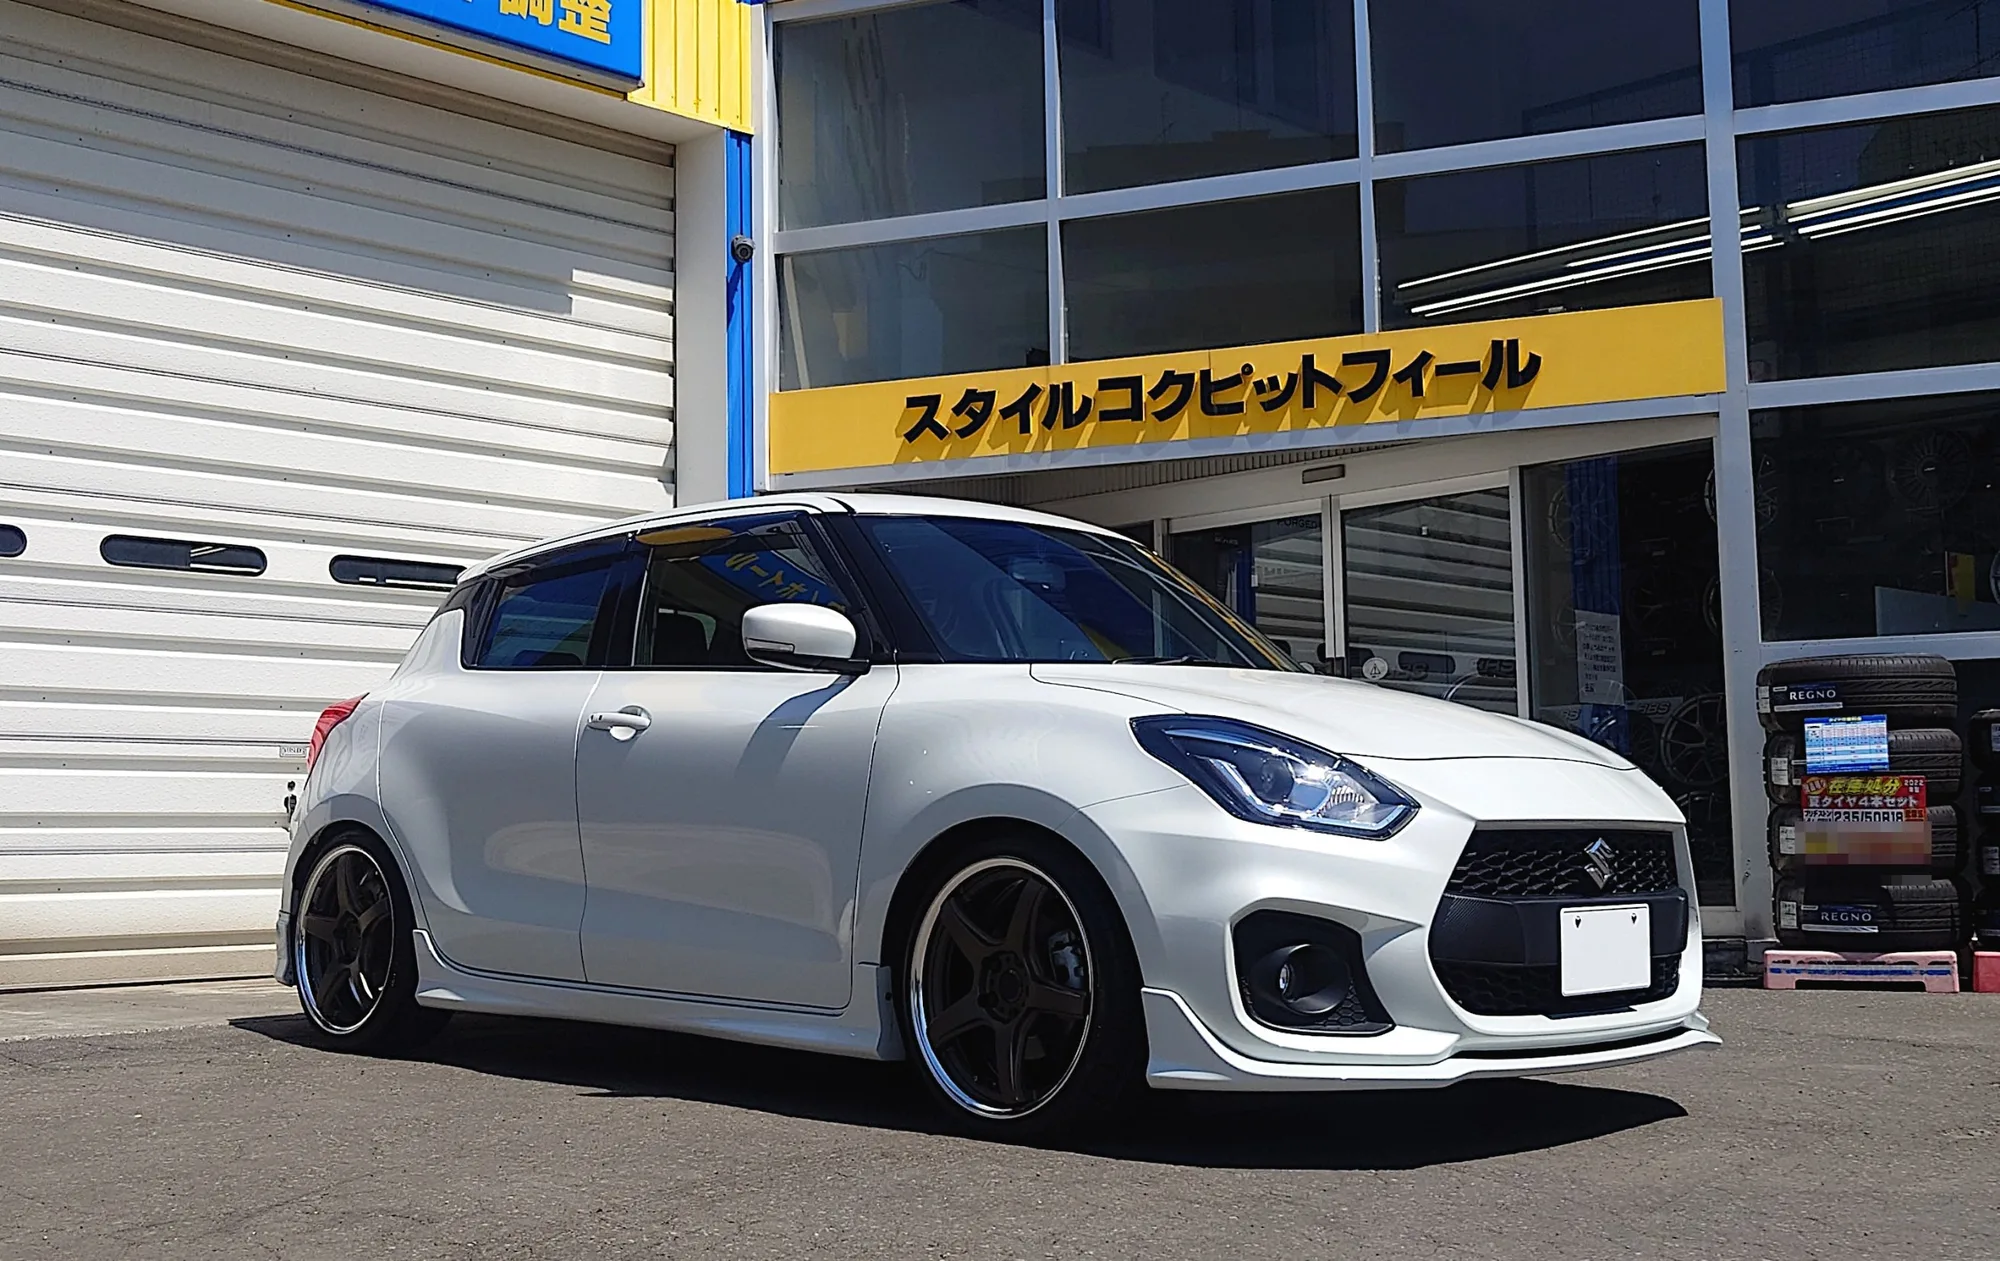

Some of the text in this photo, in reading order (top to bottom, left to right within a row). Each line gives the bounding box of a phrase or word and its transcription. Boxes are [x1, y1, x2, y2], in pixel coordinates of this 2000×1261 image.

[902, 338, 1543, 443] スタイルコクピットフィール
[1789, 689, 1837, 701] REGNO
[1828, 777, 1901, 796] 在庫処分
[1904, 779, 1925, 787] 2022
[1808, 795, 1918, 808] 夏タイヤ4本セット
[1820, 912, 1873, 922] REGNO
